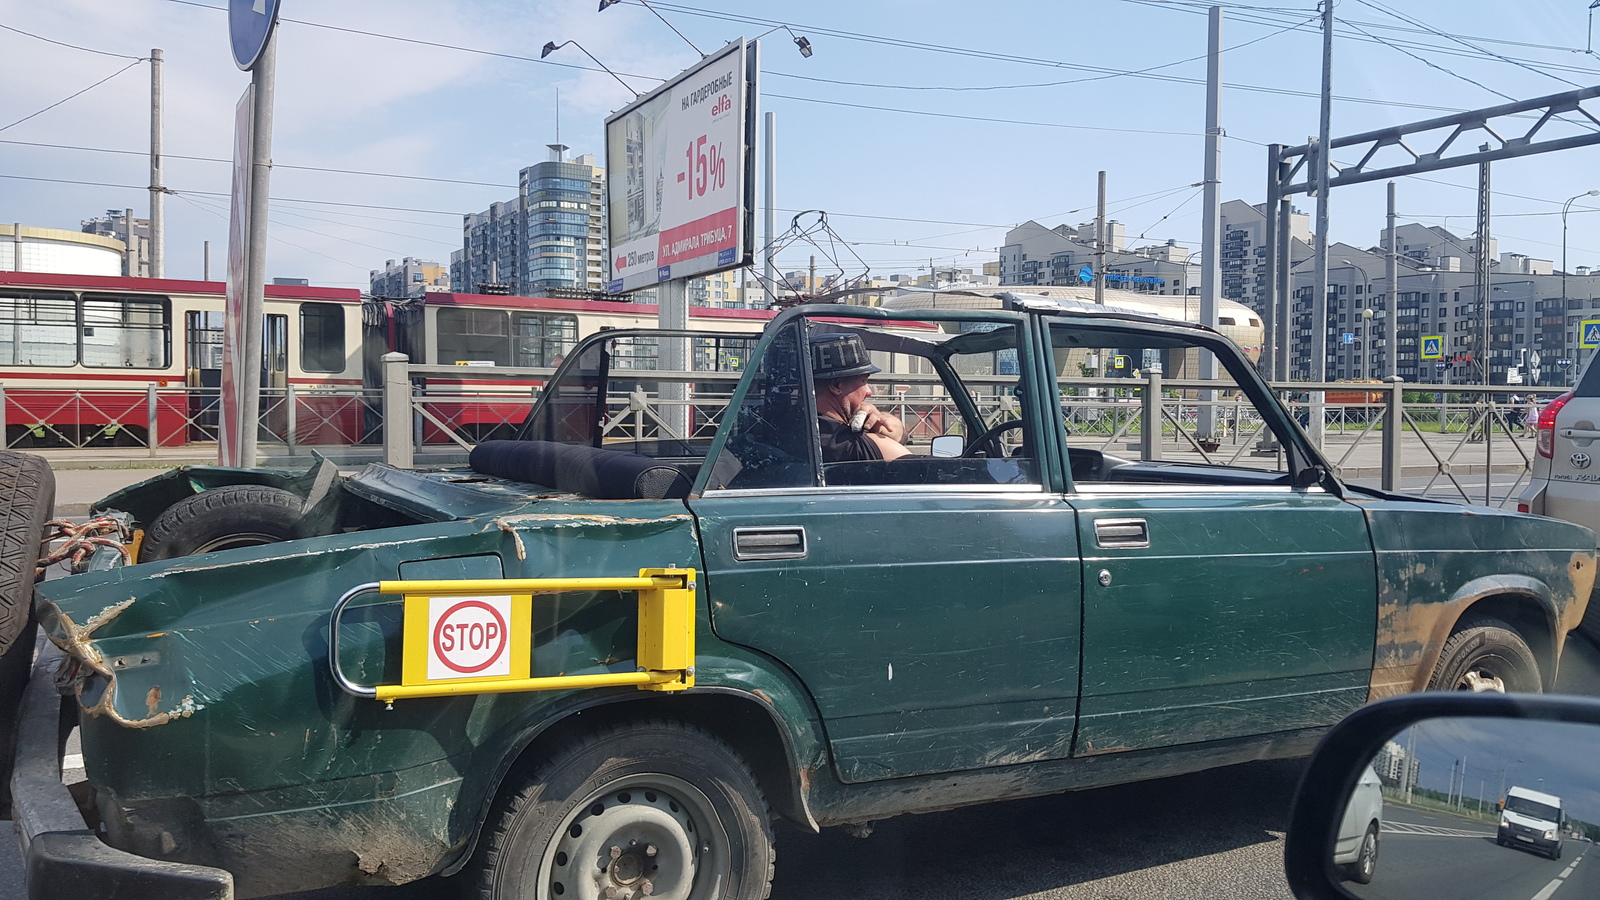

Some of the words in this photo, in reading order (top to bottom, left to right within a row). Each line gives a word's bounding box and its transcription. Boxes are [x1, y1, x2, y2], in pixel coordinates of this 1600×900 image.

[681, 96, 689, 111] НА
[690, 71, 732, 106] ГАРДЕРОБНЫЕ
[712, 94, 731, 116] elfa
[677, 134, 725, 200] -15%
[662, 244, 671, 258] УЛ.
[672, 235, 700, 256] АДМИРАЛА
[728, 224, 733, 239] 7
[628, 251, 637, 267] 250
[638, 251, 654, 265] метров
[442, 622, 499, 652] STOP
